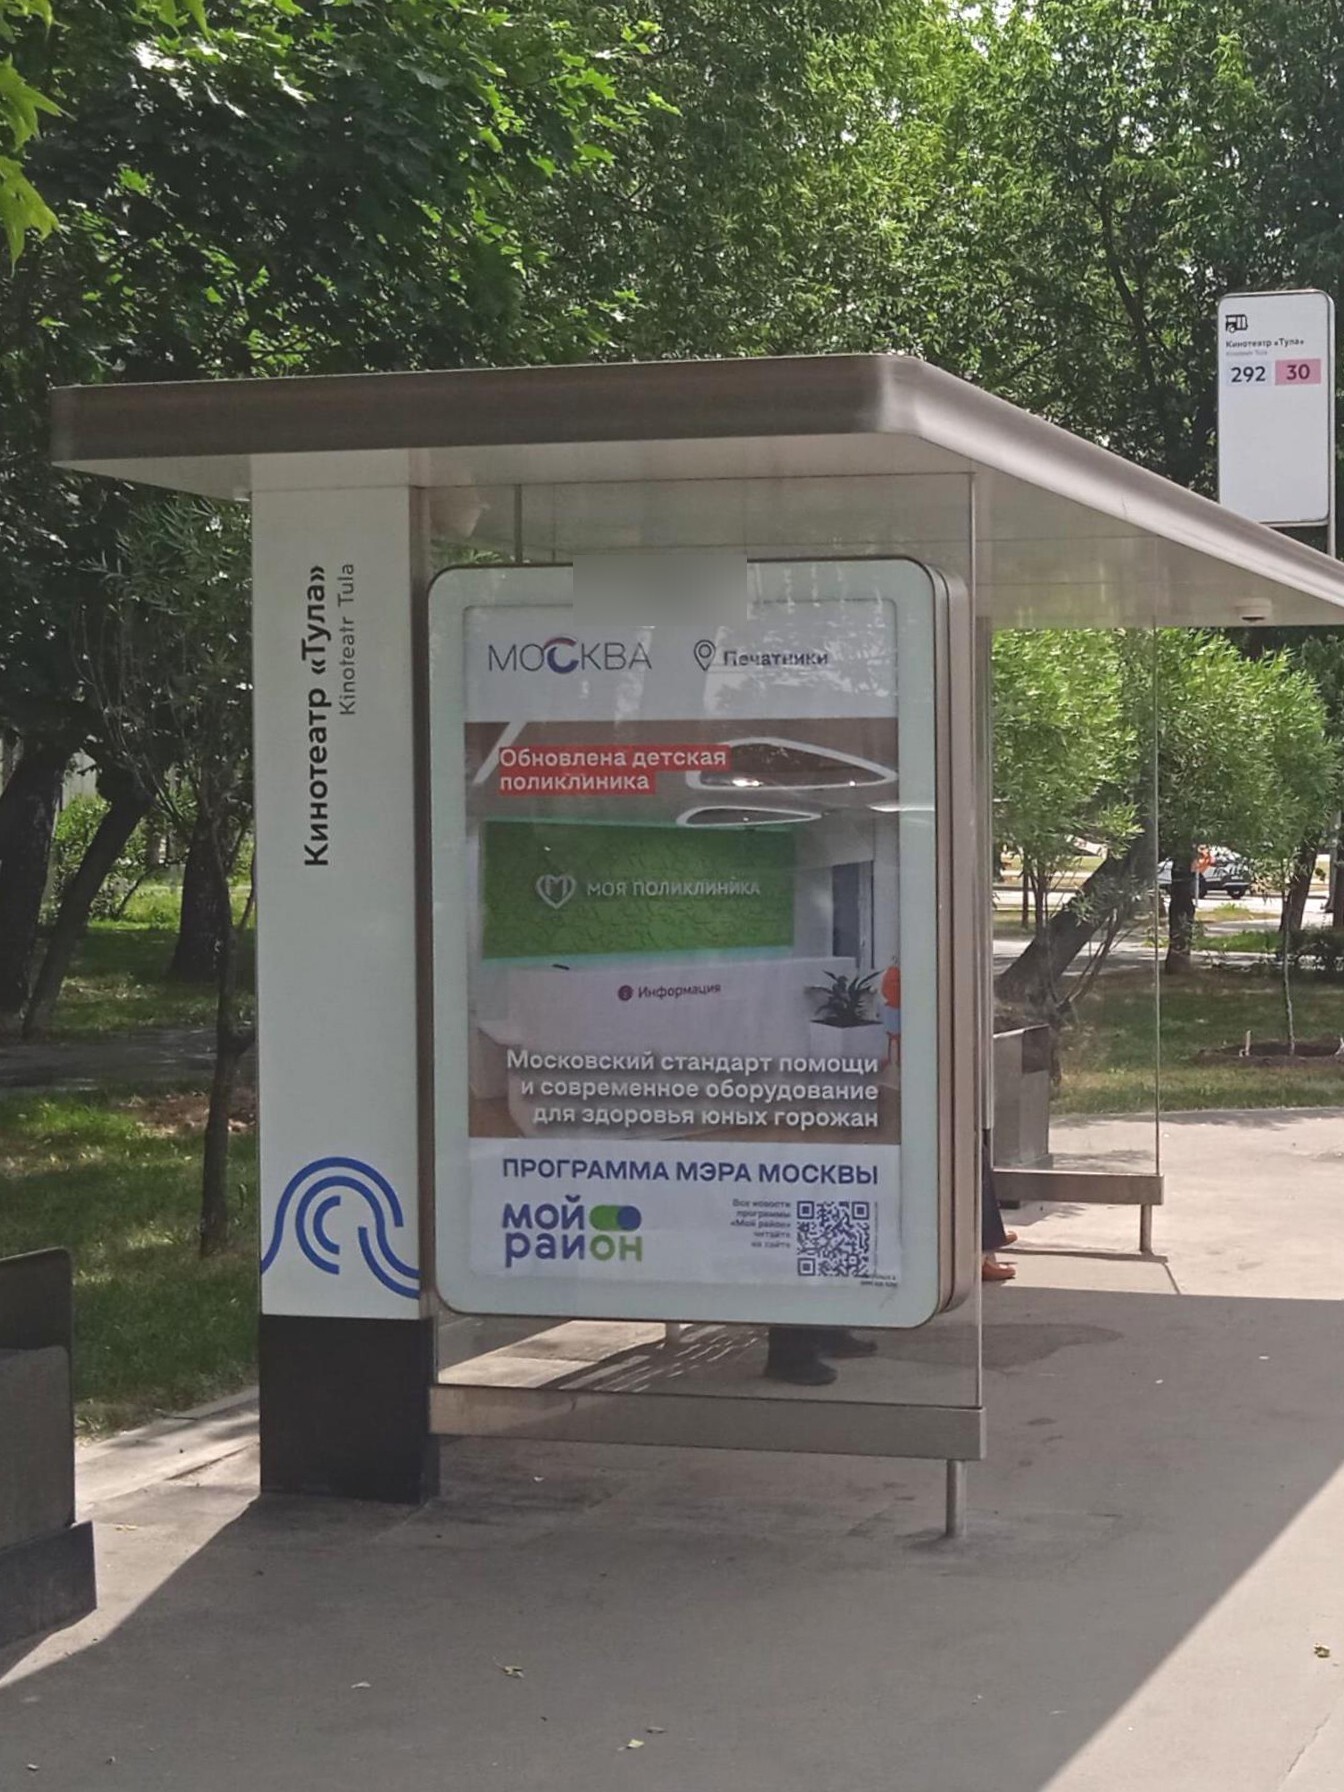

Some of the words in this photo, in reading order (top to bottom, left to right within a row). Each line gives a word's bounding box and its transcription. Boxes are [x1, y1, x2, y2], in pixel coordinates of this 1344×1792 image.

[1226, 340, 1272, 348] Кинотеатр
[1231, 366, 1266, 383] 292
[1286, 364, 1311, 381] 30
[336, 563, 355, 607] Tula
[301, 564, 332, 675] «Тула»
[338, 616, 357, 716] Kinoteatr
[488, 636, 653, 674] МОСКВА
[723, 650, 829, 668] Печатники
[500, 748, 627, 768] Обновлена
[632, 749, 727, 771] детская
[304, 687, 332, 867] Кинотеатр
[500, 773, 650, 792] поликлиника
[638, 984, 722, 1000] Информация
[506, 1049, 655, 1072] Московский
[661, 1054, 773, 1077] стандарт
[779, 1057, 878, 1076] помощи
[521, 1082, 534, 1096] и
[540, 1081, 699, 1099] современное
[706, 1079, 878, 1104] оборудование
[532, 1107, 576, 1125] для
[582, 1108, 694, 1127] здоровья
[701, 1110, 768, 1127] юных
[774, 1111, 878, 1131] горожан
[503, 1158, 670, 1181] ПРОГРАММА
[675, 1161, 751, 1183] МЭРА
[759, 1163, 878, 1186] МОСКВЫ
